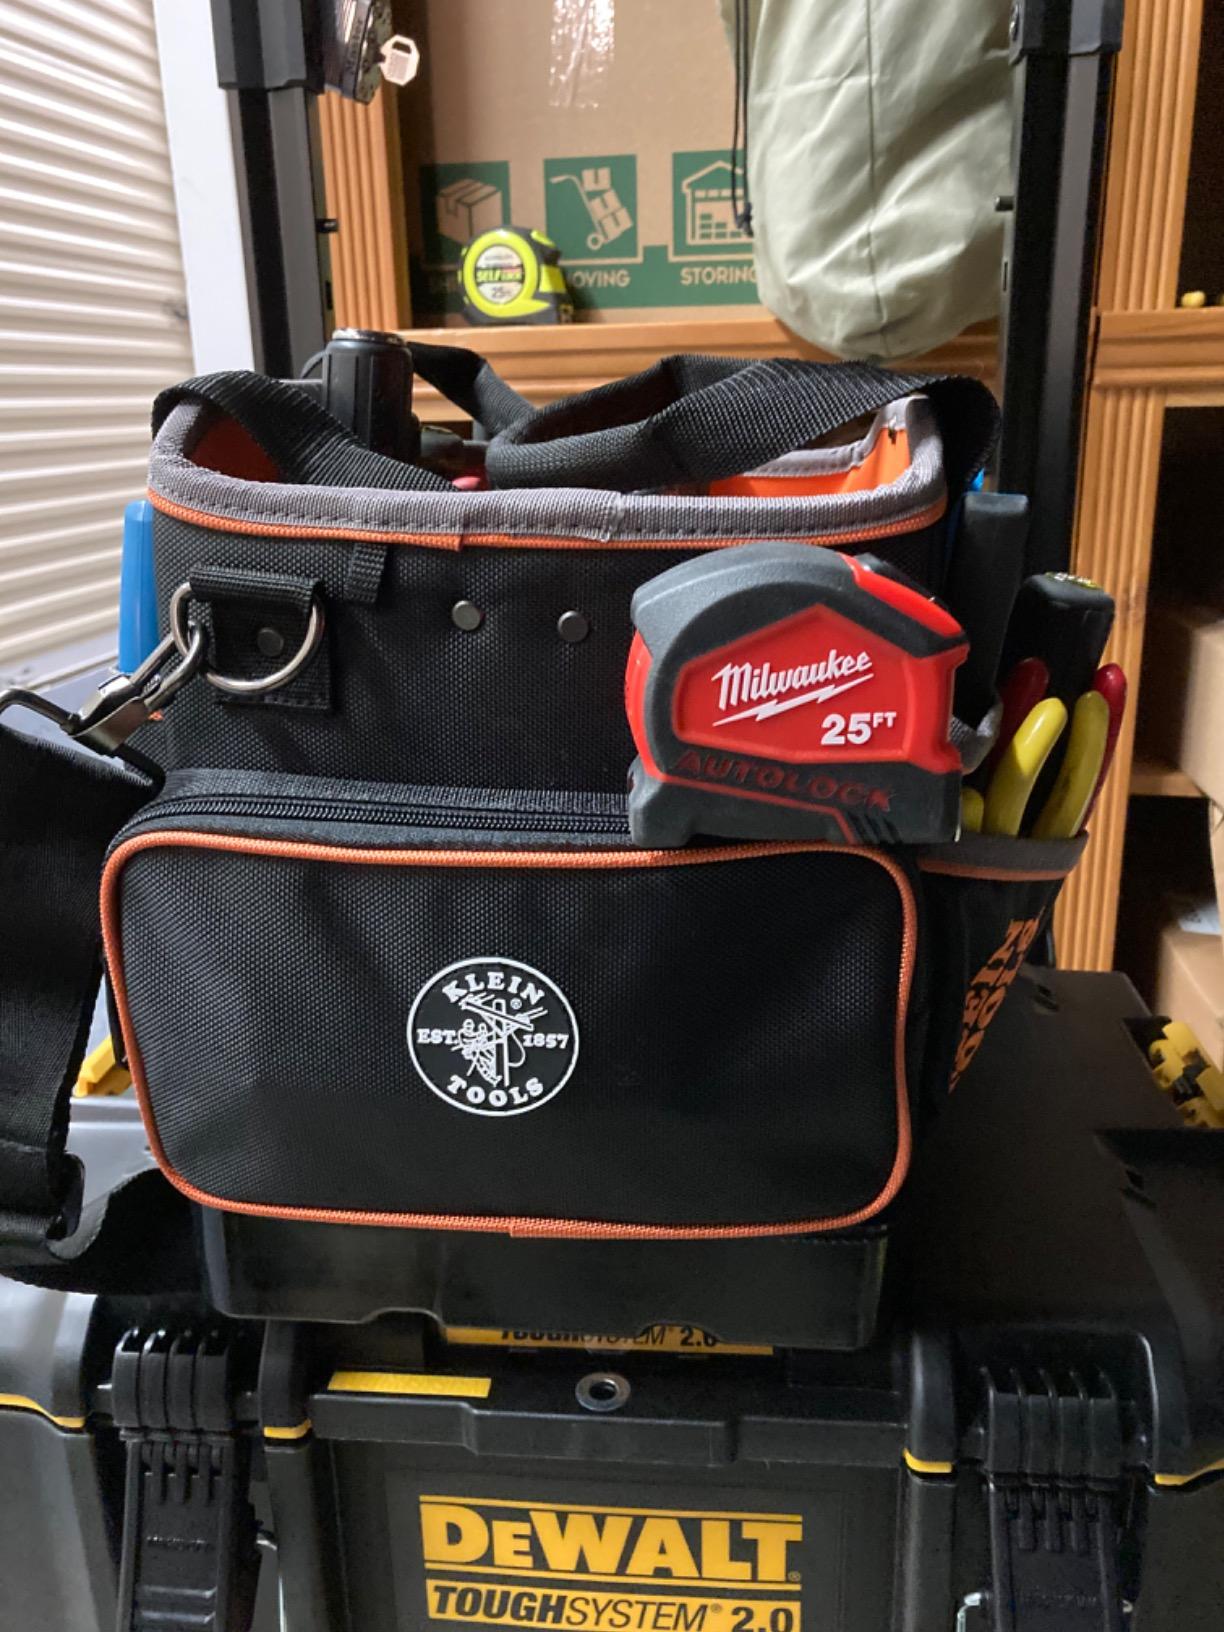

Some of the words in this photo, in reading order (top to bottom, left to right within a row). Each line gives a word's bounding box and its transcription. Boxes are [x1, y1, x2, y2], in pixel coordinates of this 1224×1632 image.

[711, 649, 873, 711] Milwaukee
[675, 749, 895, 812] AUTOLOCK
[442, 971, 546, 1005] KLEIN
[523, 1032, 570, 1049] 1857
[446, 1074, 545, 1108] TOOLS
[433, 1585, 707, 1632] TOUGHSYSTEM
